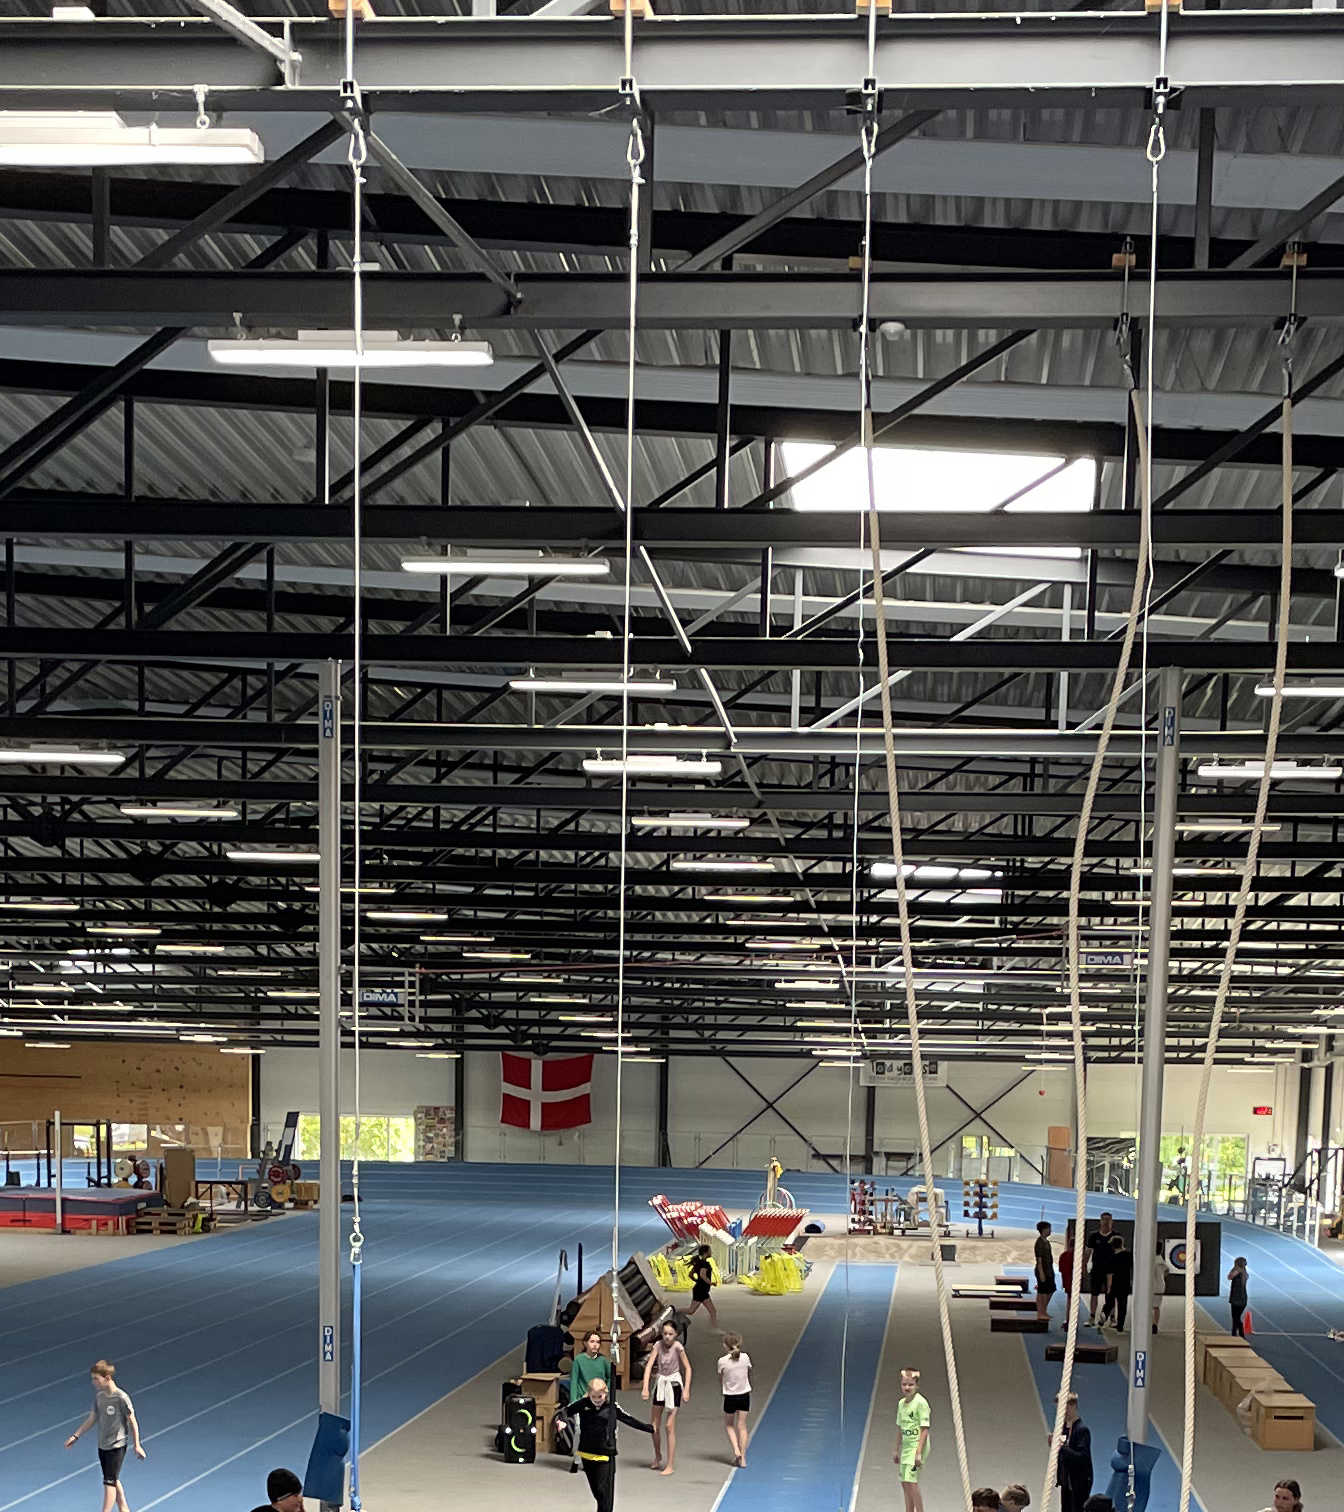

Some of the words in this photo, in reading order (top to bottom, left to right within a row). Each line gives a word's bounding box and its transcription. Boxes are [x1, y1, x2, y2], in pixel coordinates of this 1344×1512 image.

[324, 701, 332, 737] DIMA
[1087, 955, 1122, 964] DIMA
[363, 993, 397, 1002] DIMA
[324, 1326, 333, 1360] DIMA
[1136, 1352, 1145, 1386] DIMA
